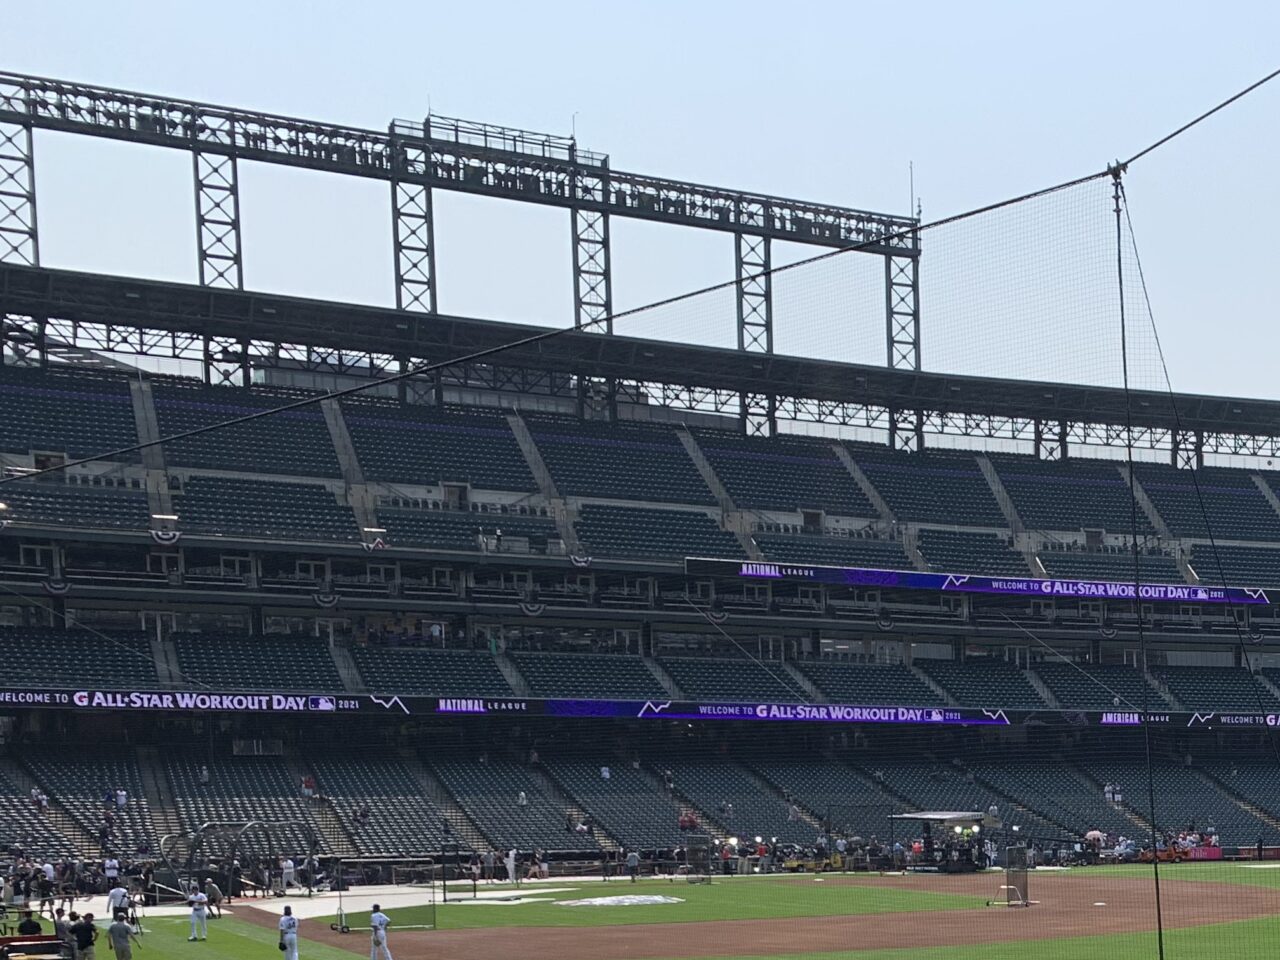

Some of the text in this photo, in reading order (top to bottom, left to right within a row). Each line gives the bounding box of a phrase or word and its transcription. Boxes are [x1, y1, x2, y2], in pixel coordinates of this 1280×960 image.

[741, 563, 814, 577] NATIONAL LEAGUE
[991, 581, 1027, 590] WELCOME
[1030, 582, 1039, 590] TO
[1167, 586, 1190, 599] DAY
[55, 692, 69, 703] TO
[175, 693, 269, 711] WORKOUT
[271, 695, 306, 711] DAY
[338, 700, 359, 709] 2021
[438, 698, 527, 712] NATIONAL LEAGUE
[698, 705, 740, 715] WELCOME
[742, 705, 754, 715] TO
[829, 706, 897, 720] WORKOUT
[898, 708, 922, 721] DAY
[1102, 712, 1139, 723] AMERICAN
[1220, 716, 1254, 724] WELCOME
[1255, 716, 1264, 724] TO
